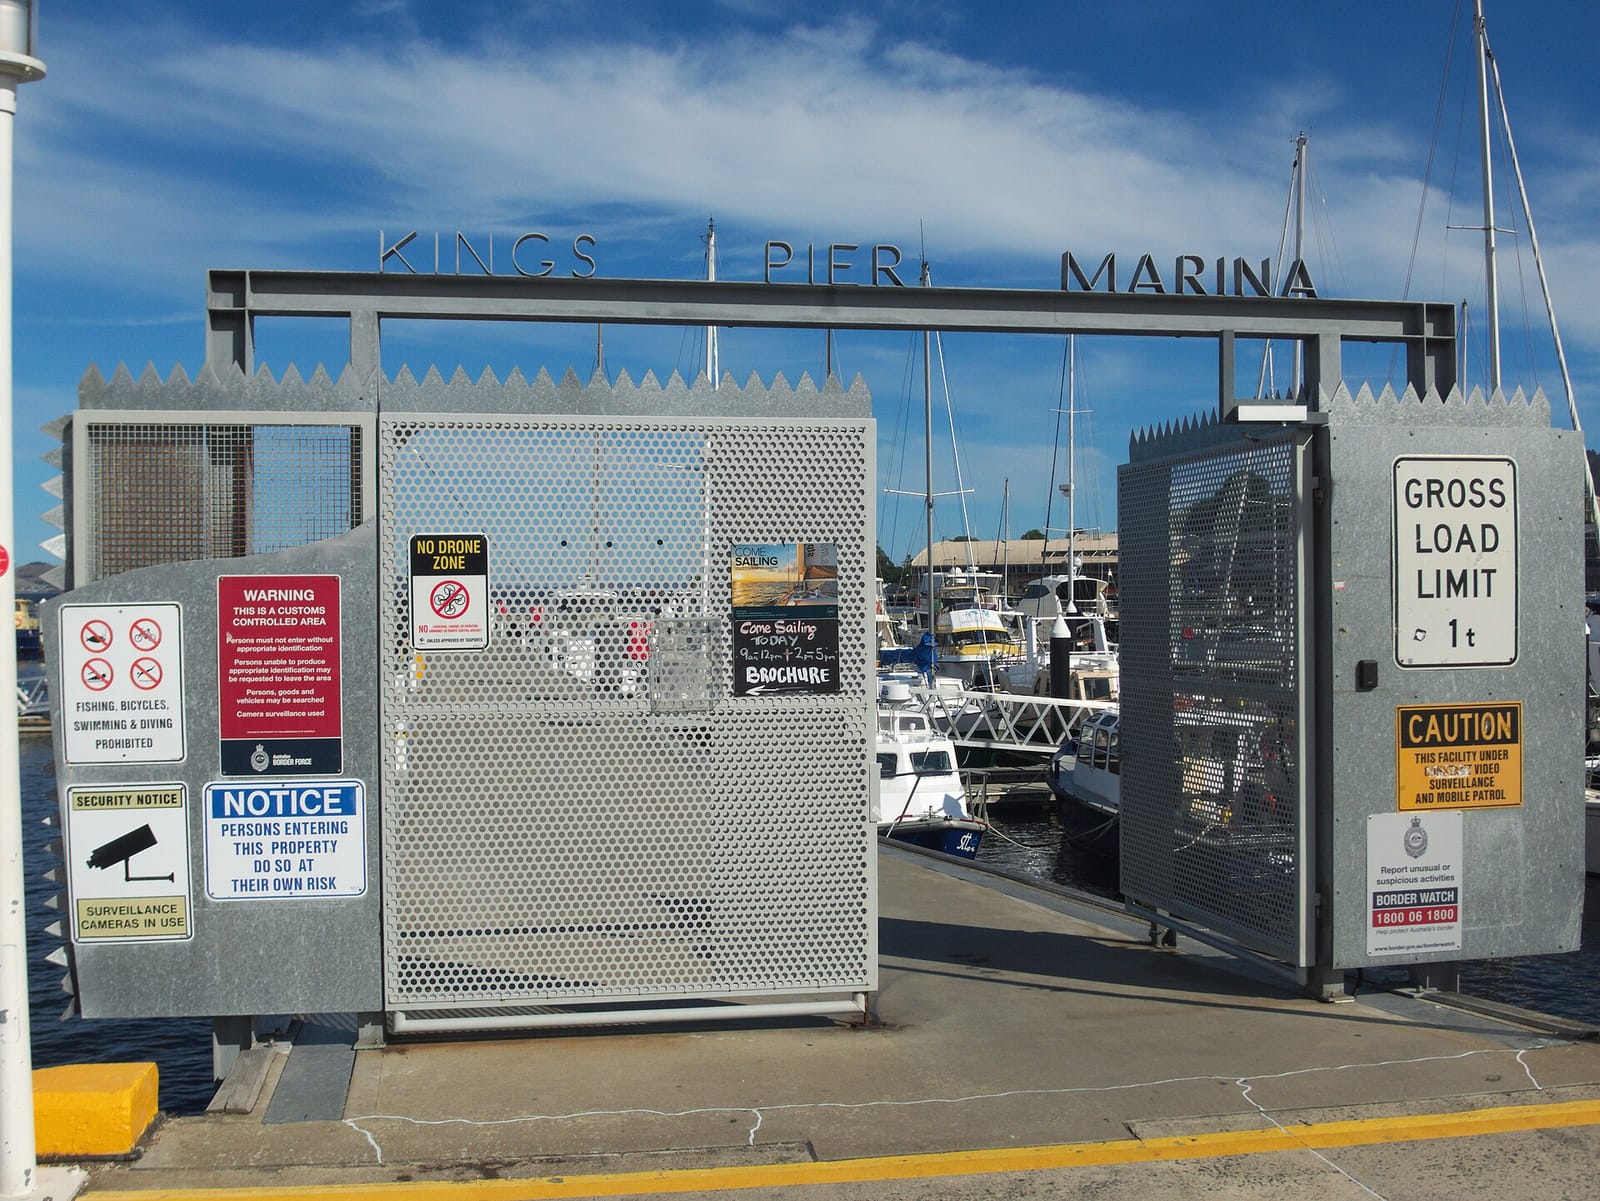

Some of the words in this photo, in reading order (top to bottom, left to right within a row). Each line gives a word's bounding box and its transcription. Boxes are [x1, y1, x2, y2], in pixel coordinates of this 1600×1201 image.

[379, 229, 597, 278] KINGS
[765, 240, 904, 287] PIER
[1061, 250, 1318, 299] MARINA
[1405, 478, 1506, 508] GROSS
[1416, 524, 1500, 554] LOAD
[416, 540, 434, 554] NO
[438, 540, 480, 554] DRONE
[735, 547, 767, 557] COME
[432, 556, 466, 570] ZONE
[735, 557, 778, 566] SAILING
[1418, 569, 1497, 598] LIMIT
[244, 589, 314, 601] WARNING
[233, 606, 255, 616] THIS
[258, 606, 266, 616] IS
[268, 606, 276, 615] A
[278, 606, 326, 614] CUSTOMS
[232, 618, 298, 626] CONTROLLED
[300, 617, 326, 626] AREA
[418, 624, 428, 633] NO
[740, 621, 772, 634] Come
[774, 620, 816, 640] Sailing
[298, 658, 326, 666] produce
[746, 666, 830, 684] BROCHURE
[278, 688, 300, 696] goods
[76, 701, 118, 712] FISHING,
[120, 700, 169, 711] BICYCLES,
[74, 720, 127, 732] SWIMMING
[130, 720, 137, 730] &
[140, 718, 172, 730] DIVING
[1409, 712, 1512, 744] CAUTION
[96, 738, 152, 750] PROHIBITED
[1414, 752, 1436, 764] THIS
[1438, 751, 1478, 762] FACILITY
[1480, 750, 1508, 761] UNDER
[1474, 763, 1500, 774] VIDEO
[1429, 777, 1494, 790] SURVEILLANCE
[77, 795, 132, 807] SECURITY
[136, 793, 178, 805] NOTICE
[224, 789, 342, 816] NOTICE
[1416, 794, 1434, 804] AND
[1437, 791, 1470, 803] MOBILE
[1473, 789, 1506, 801] PATROL
[221, 822, 280, 837] PERSONS
[285, 820, 348, 836] ENTERING
[234, 842, 263, 856] THIS
[272, 840, 338, 855] PROPERTY
[254, 860, 270, 873] DO
[275, 859, 291, 872] SO
[298, 858, 314, 872] AT
[1380, 866, 1408, 875] Report
[1410, 864, 1440, 872] unusual
[232, 878, 269, 892] THEIR
[274, 878, 302, 892] OWN
[307, 876, 336, 890] RISK
[1376, 876, 1418, 886] suspicious
[1420, 874, 1454, 882] activities
[1376, 893, 1417, 906] BORDER
[1420, 890, 1454, 904] WATCH
[86, 904, 178, 916] SURVEILLANCE
[1377, 912, 1404, 924] 1800
[1408, 911, 1422, 922] 06
[1427, 909, 1454, 921] 1800
[81, 919, 140, 930] CAMERAS
[144, 918, 156, 928] IN
[160, 917, 184, 928] USE
